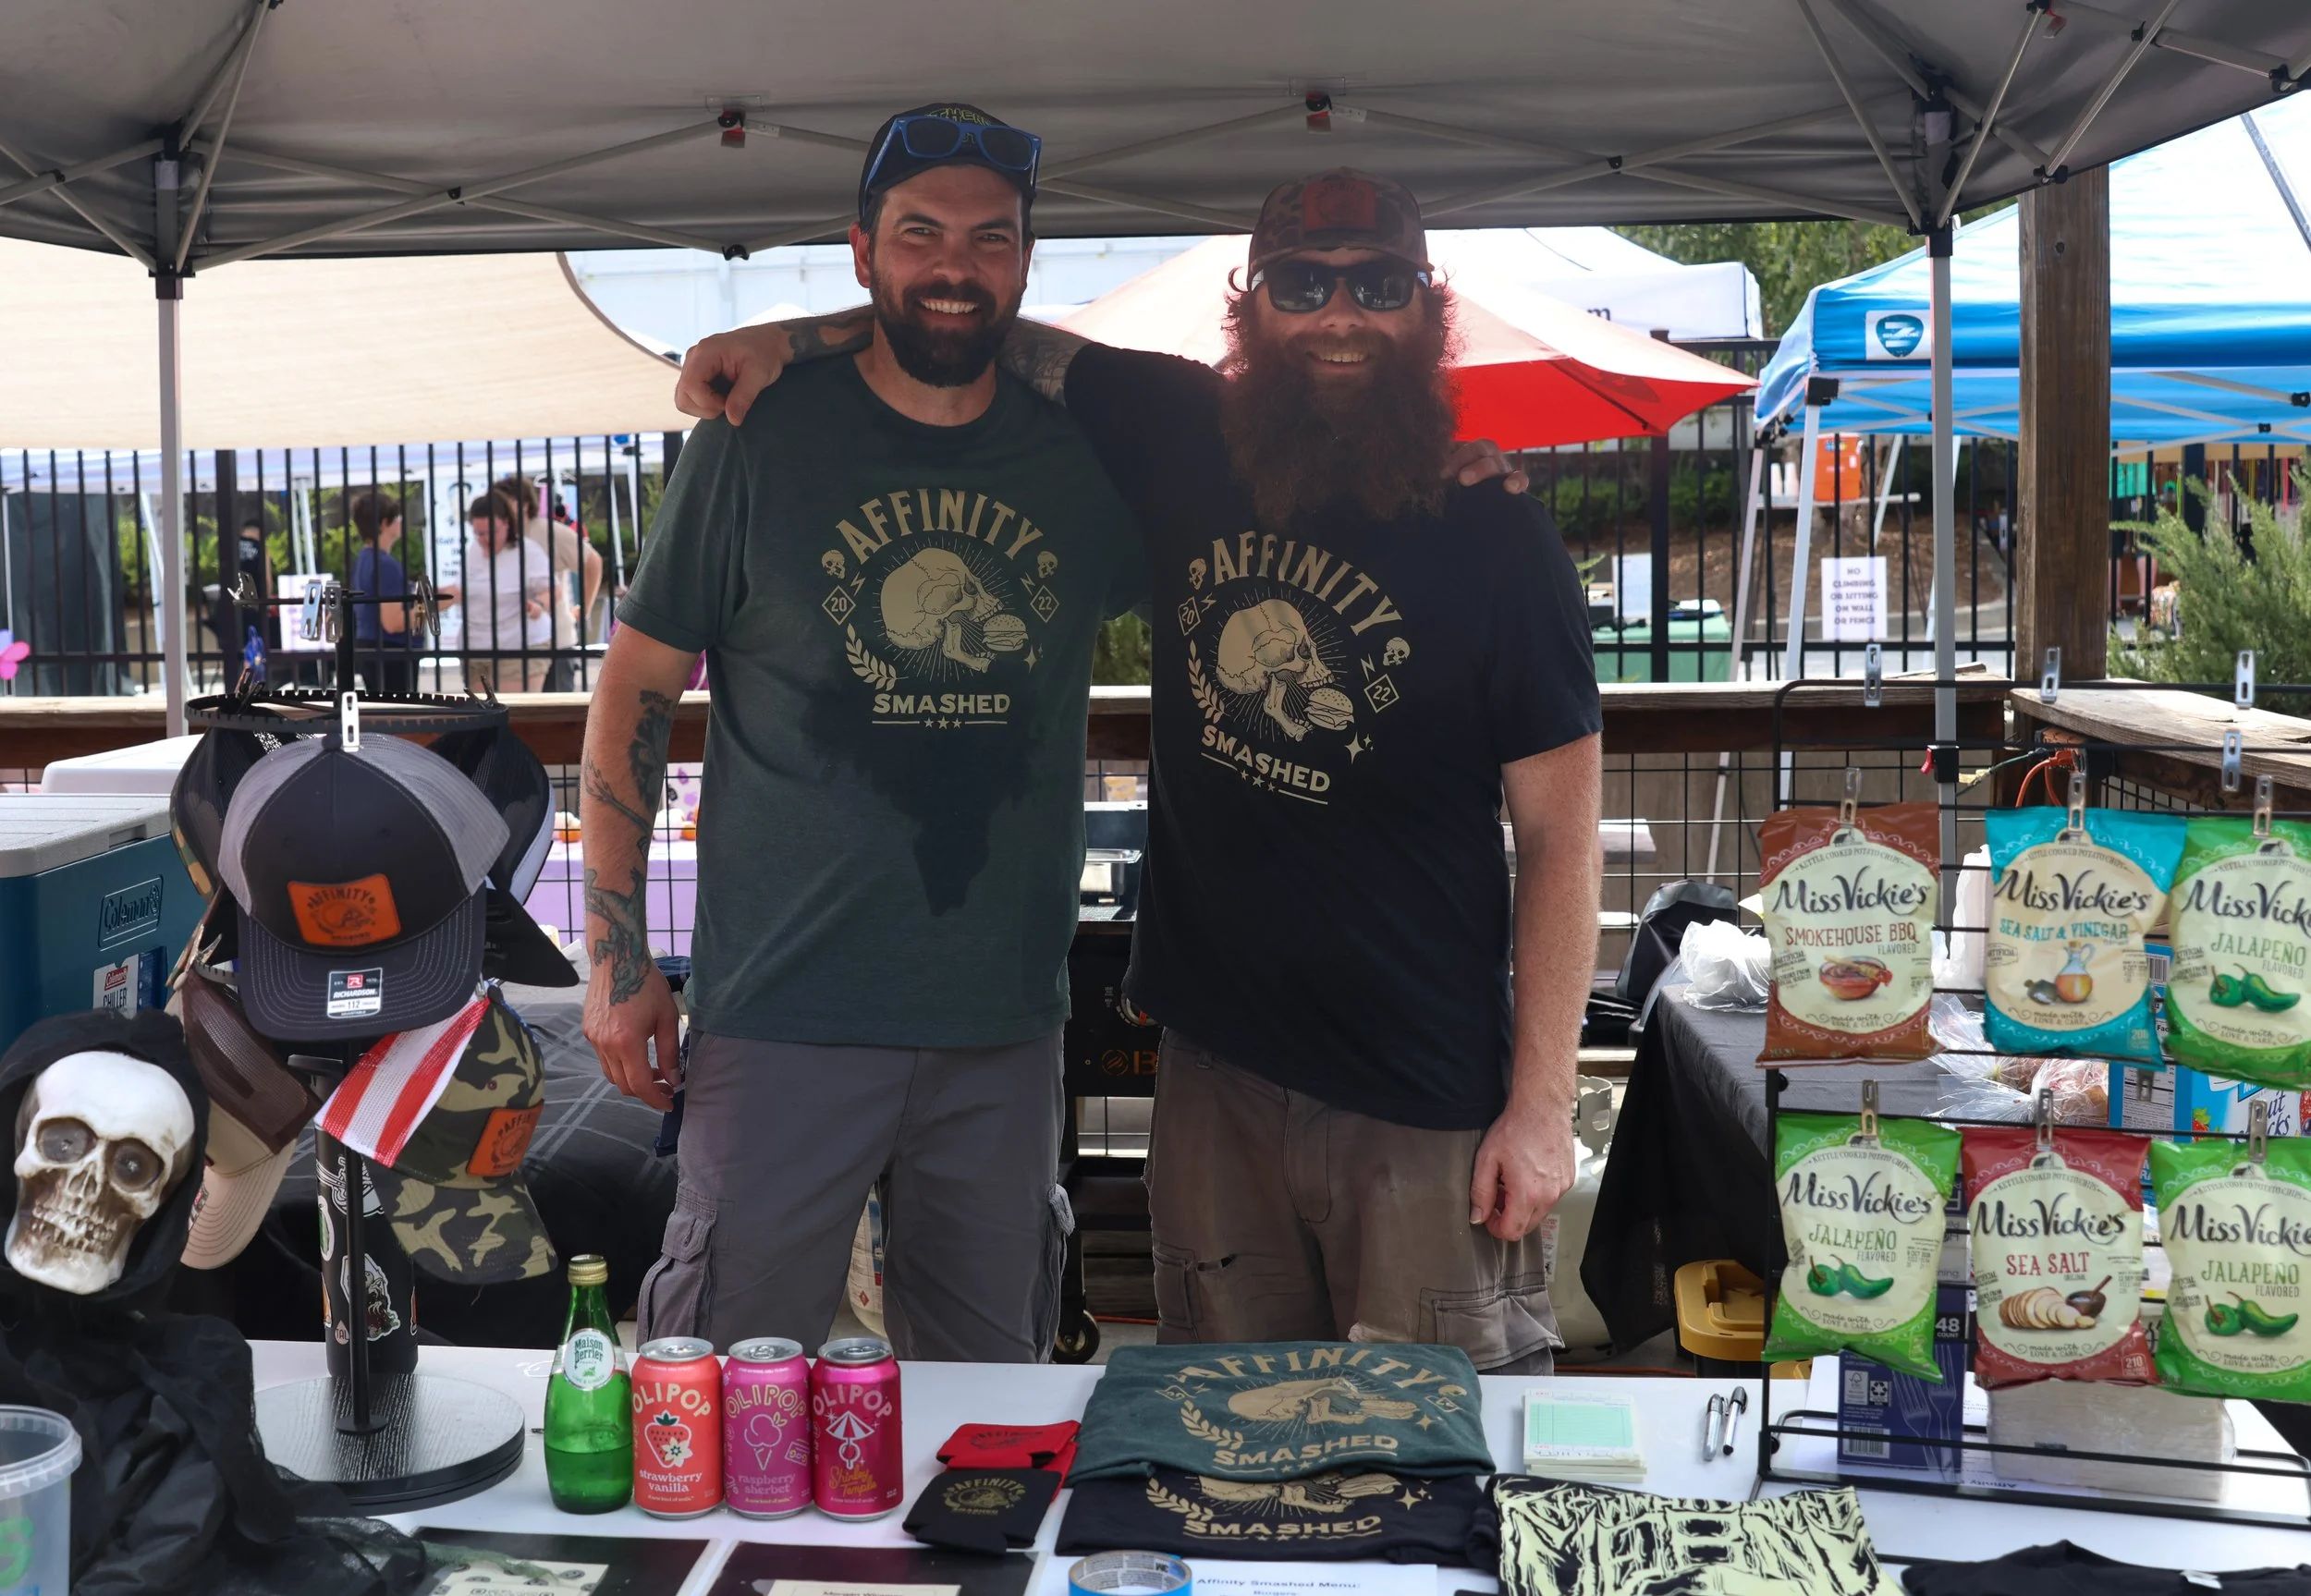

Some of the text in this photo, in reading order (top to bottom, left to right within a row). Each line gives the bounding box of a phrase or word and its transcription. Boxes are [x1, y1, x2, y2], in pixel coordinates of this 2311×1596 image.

[836, 488, 1044, 565] AFFINITY
[1212, 530, 1403, 637] AFFINITY
[831, 597, 848, 613] 20
[1037, 596, 1053, 611] 22
[1182, 605, 1195, 625] 20
[873, 693, 1010, 714] SMASHED
[1372, 685, 1391, 702] 22
[1202, 725, 1331, 793] SMASHED
[309, 887, 370, 909] AFFINITY
[1771, 865, 1929, 916] Miss Vickie's
[1994, 870, 2151, 918] Miss Vickie's
[2182, 879, 2256, 918] Miss
[1785, 922, 1920, 947] SMOKEHOUSE BBQ
[1999, 919, 2129, 942] SEA SALT & VINEGAR
[1877, 944, 1916, 956] FLAVORED
[2210, 932, 2306, 967] JALAPEÑO
[2262, 958, 2305, 980] FLAVORED
[104, 988, 128, 1009] CHILLER
[1782, 1171, 1848, 1210] Miss
[1845, 1171, 1932, 1224] Vickie's
[1974, 1200, 2039, 1238] Miss
[2033, 1192, 2125, 1245] Vickie's
[2170, 1203, 2241, 1243] Miss
[1809, 1224, 1897, 1249] JALAPEÑO
[1856, 1250, 1896, 1262] FLAVORED
[2006, 1252, 2089, 1276] SEA SALT
[2201, 1260, 2299, 1285] JALAPEÑO
[2255, 1285, 2300, 1298] FLAVORED
[1936, 1318, 1960, 1333] 48
[574, 1337, 604, 1352] Maison
[1180, 1347, 1447, 1389] AFFINITY
[2125, 1356, 2143, 1367] 210
[632, 1382, 711, 1418] OLIPOP
[726, 1384, 807, 1418] OLIPOP
[813, 1383, 893, 1418] OLIPOP
[1213, 1434, 1399, 1466] SMASHED
[639, 1470, 703, 1483] strawberry
[648, 1482, 690, 1492] vanilla
[739, 1474, 796, 1486] raspberry
[955, 1478, 1021, 1492] AFFINITY
[744, 1482, 791, 1494] sherbet
[840, 1479, 876, 1497] Temple
[1185, 1516, 1383, 1535] SMASHED
[1196, 1578, 1246, 1586] Affinity
[1250, 1579, 1314, 1588] Smashed
